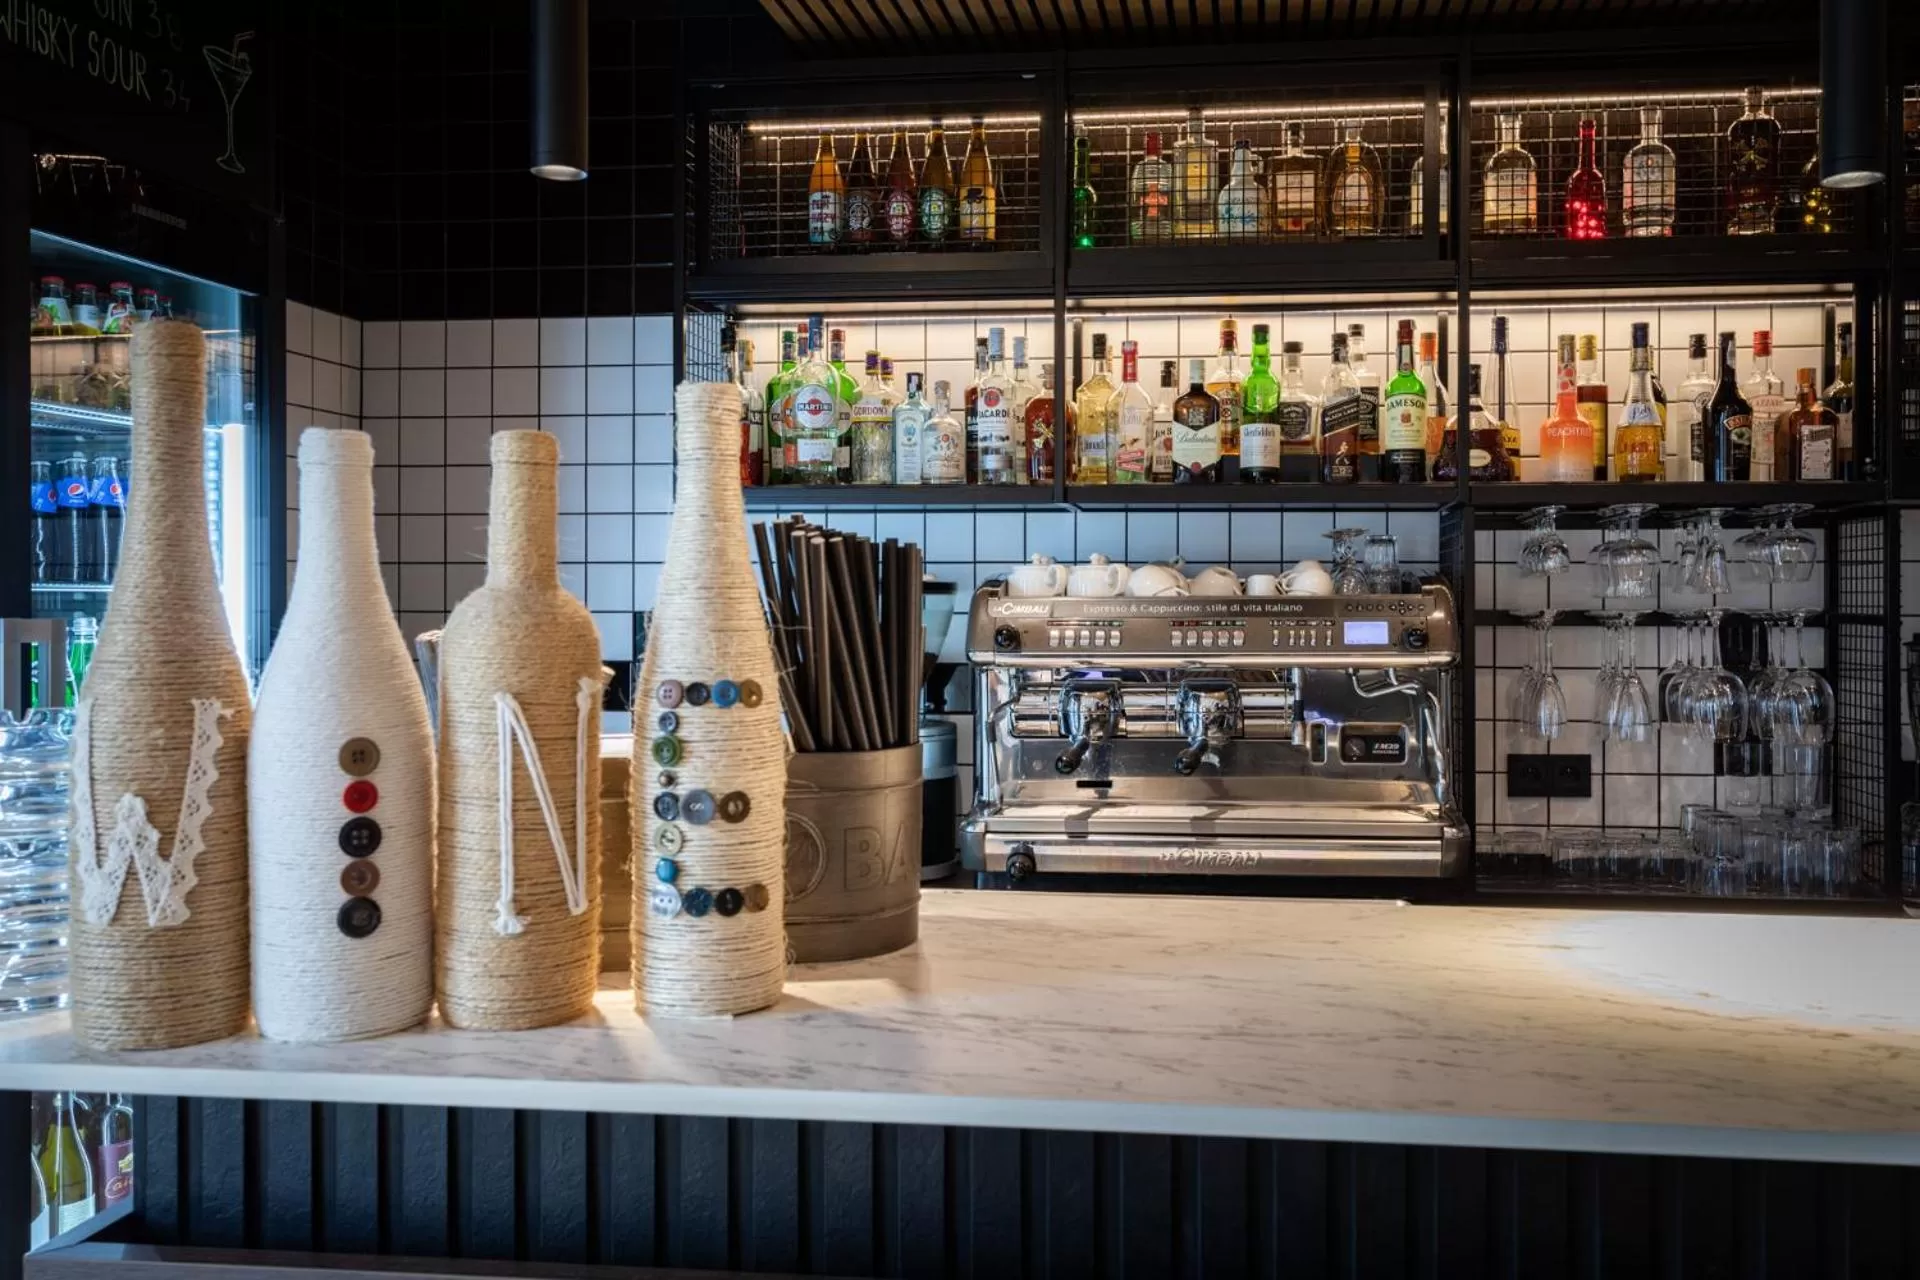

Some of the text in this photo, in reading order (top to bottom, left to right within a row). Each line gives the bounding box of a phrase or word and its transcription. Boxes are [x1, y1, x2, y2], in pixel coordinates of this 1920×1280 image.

[88, 30, 151, 103] SOUR
[1387, 398, 1425, 411] JAMESON
[1001, 602, 1049, 615] CIMBALI
[1083, 604, 1127, 614] Espresso
[1129, 604, 1138, 613] &
[1206, 602, 1229, 612] stile
[1230, 602, 1240, 612] di
[1243, 603, 1262, 612] vita
